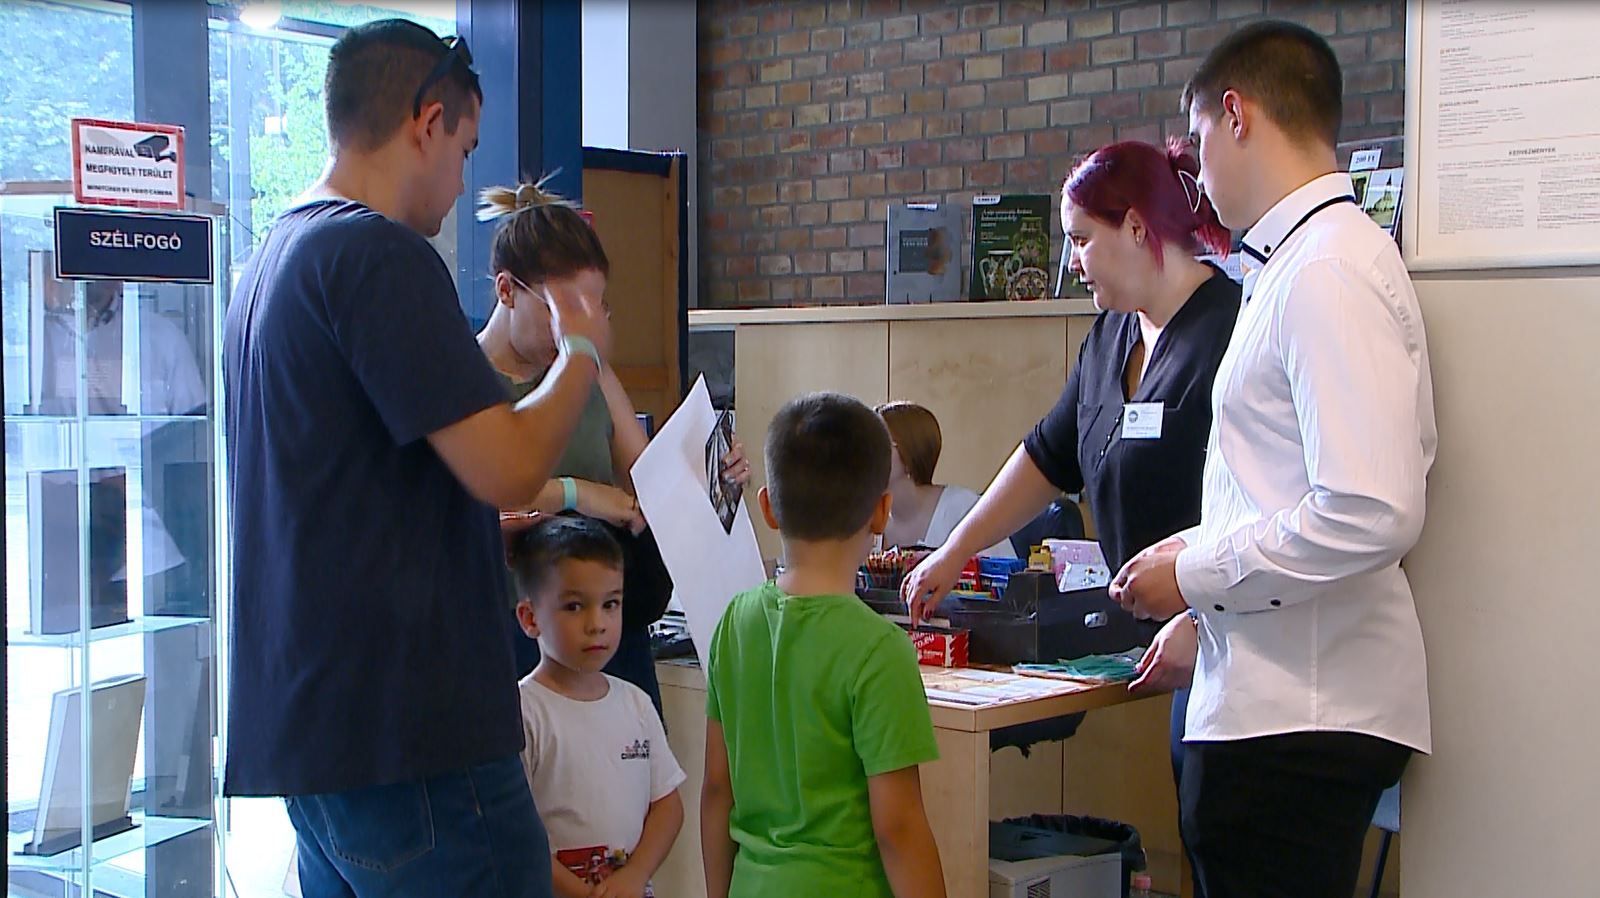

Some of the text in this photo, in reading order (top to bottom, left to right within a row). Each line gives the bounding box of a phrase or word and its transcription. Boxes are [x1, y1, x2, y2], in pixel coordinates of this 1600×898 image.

[85, 145, 135, 158] KAMERÁVAL
[86, 163, 173, 179] MEGFIGYELT TERÜLET
[90, 229, 182, 250] SZÉLFOGÓ
